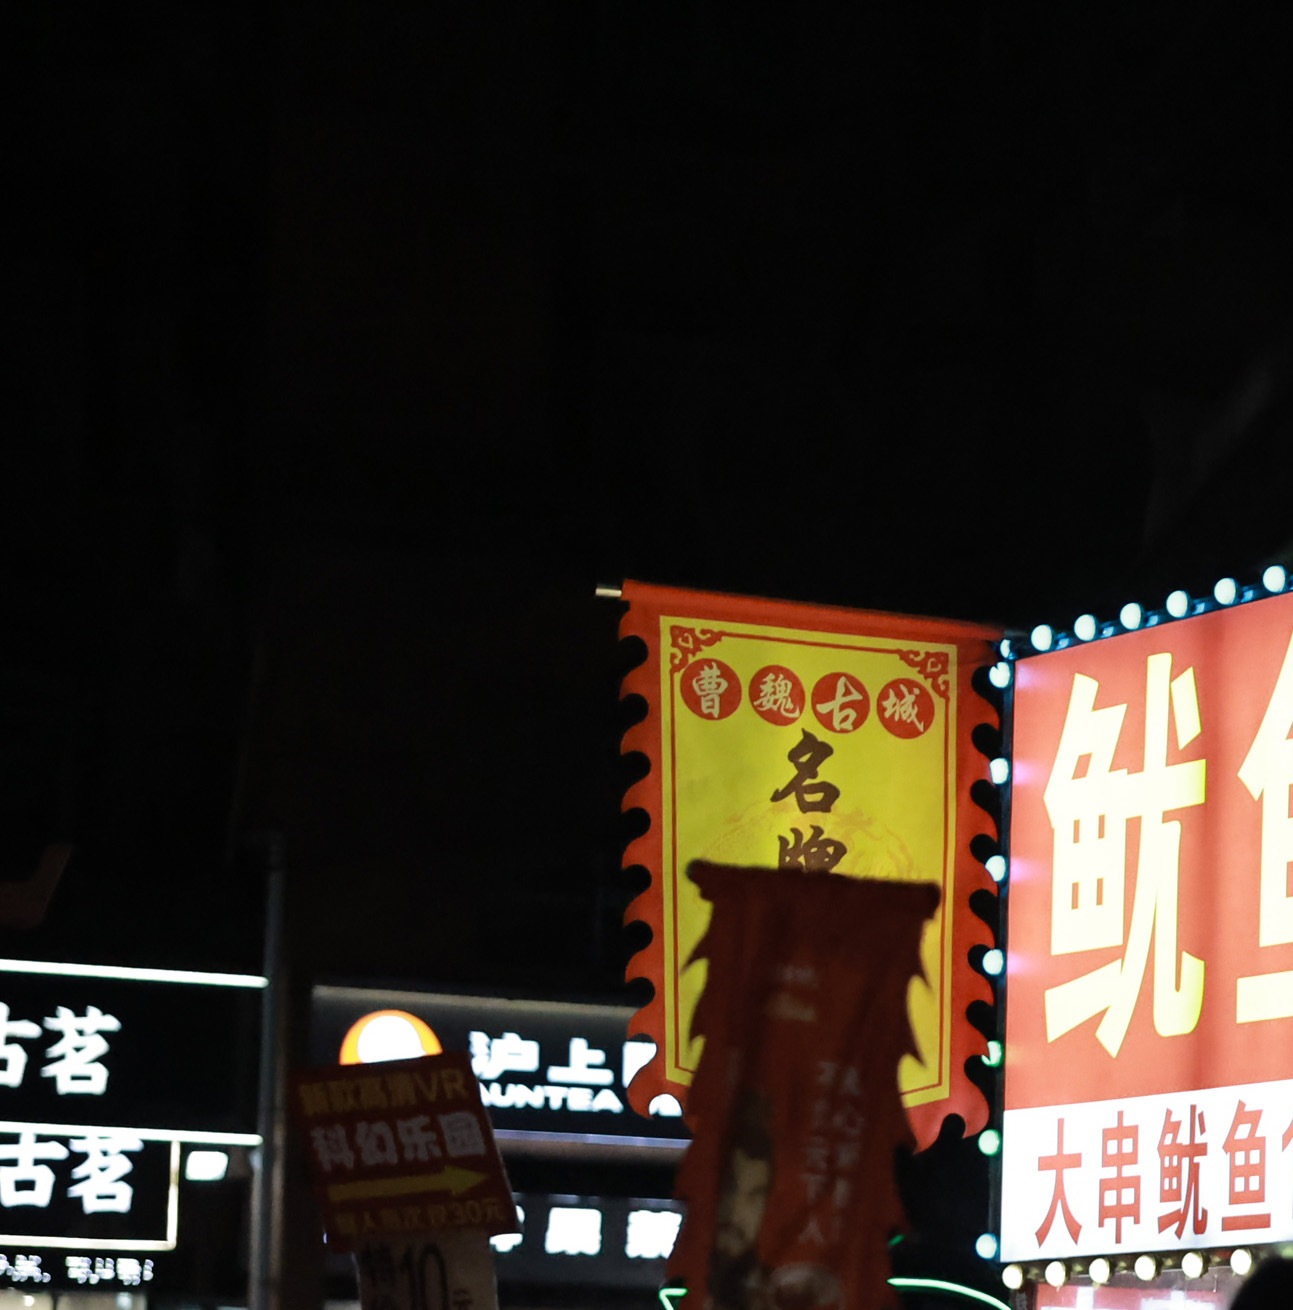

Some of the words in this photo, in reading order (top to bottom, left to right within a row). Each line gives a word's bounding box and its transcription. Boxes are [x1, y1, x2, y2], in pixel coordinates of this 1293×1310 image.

[692, 662, 925, 732] 曹魏古城
[0, 1132, 144, 1214] 古茗
